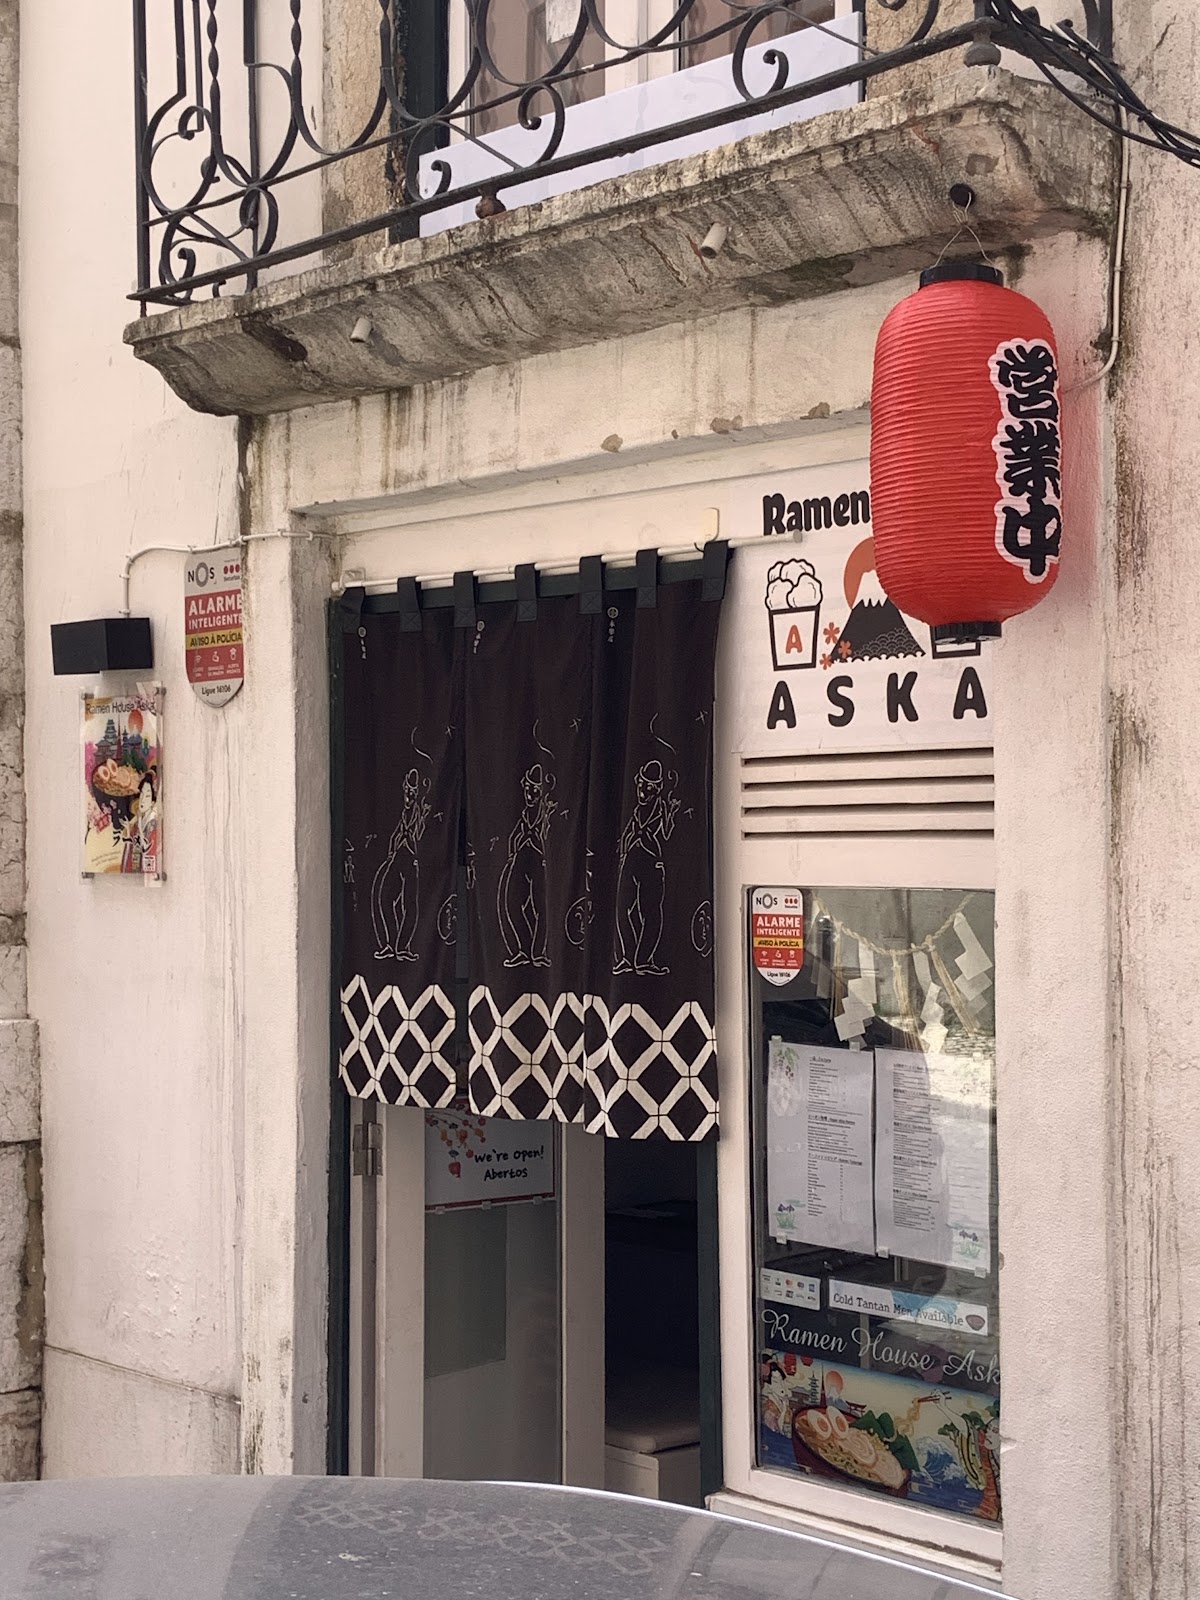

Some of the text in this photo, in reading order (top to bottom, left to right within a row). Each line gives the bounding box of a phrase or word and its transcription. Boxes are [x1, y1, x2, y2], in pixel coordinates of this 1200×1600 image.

[996, 344, 1060, 576] 営業中
[763, 490, 871, 536] Ramen
[187, 561, 215, 588] NOS
[189, 593, 242, 616] ALARME
[189, 613, 242, 630] INTELIGENTE
[190, 634, 210, 648] AVISO
[217, 631, 242, 643] POLÍCIA
[785, 623, 804, 655] A
[86, 703, 110, 714] Ramen
[112, 702, 135, 713] House
[766, 666, 988, 731] ASKA
[756, 893, 778, 909] NOS
[757, 916, 800, 928] ALARME
[757, 928, 800, 936] INTELIGENTE
[483, 1167, 528, 1182] Abertos
[833, 1292, 964, 1326] Cold Tantan Men Available
[761, 1308, 1000, 1385] Ramen House Ask
